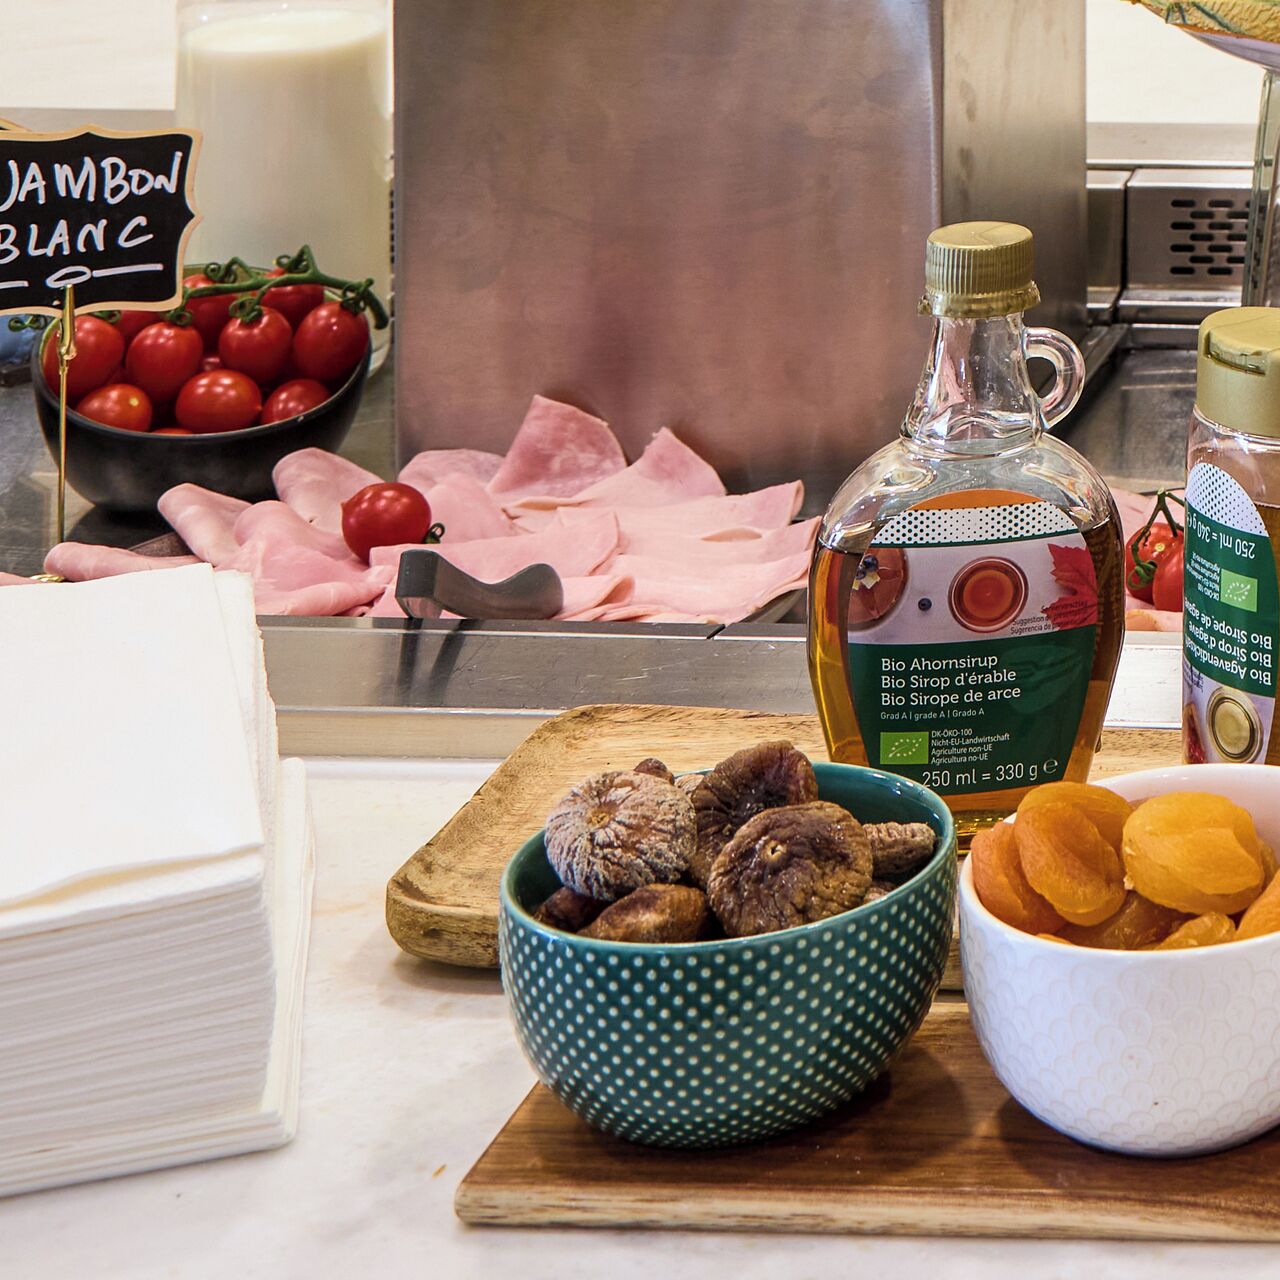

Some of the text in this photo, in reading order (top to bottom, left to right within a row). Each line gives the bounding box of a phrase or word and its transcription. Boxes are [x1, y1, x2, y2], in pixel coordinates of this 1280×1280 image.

[0, 151, 184, 213] JAMBON
[0, 215, 154, 265] BLANC
[1196, 521, 1211, 543] 340
[1219, 532, 1233, 549] ml
[1234, 538, 1256, 560] 250
[1200, 613, 1212, 629] de
[1213, 620, 1248, 645] Sirope
[1218, 638, 1247, 662] Sirop
[1250, 633, 1273, 650] Bio
[880, 654, 999, 671] Bio Ahornsirup
[1250, 651, 1272, 668] Bio
[880, 668, 1017, 690] Bio Sirop d'érable
[1249, 669, 1272, 686] Bio
[880, 686, 1022, 708] Bio Sirope de arce
[880, 707, 985, 721] Grad A grade A Grado A
[931, 732, 1010, 747] Nicht-EU-Landwirtschaft
[930, 744, 993, 756] Agriculture non-UE
[930, 753, 989, 766] Agricultura no-UE
[922, 770, 951, 788] 250
[955, 768, 978, 786] ml
[995, 762, 1024, 782] 330
[1029, 763, 1039, 781] g
